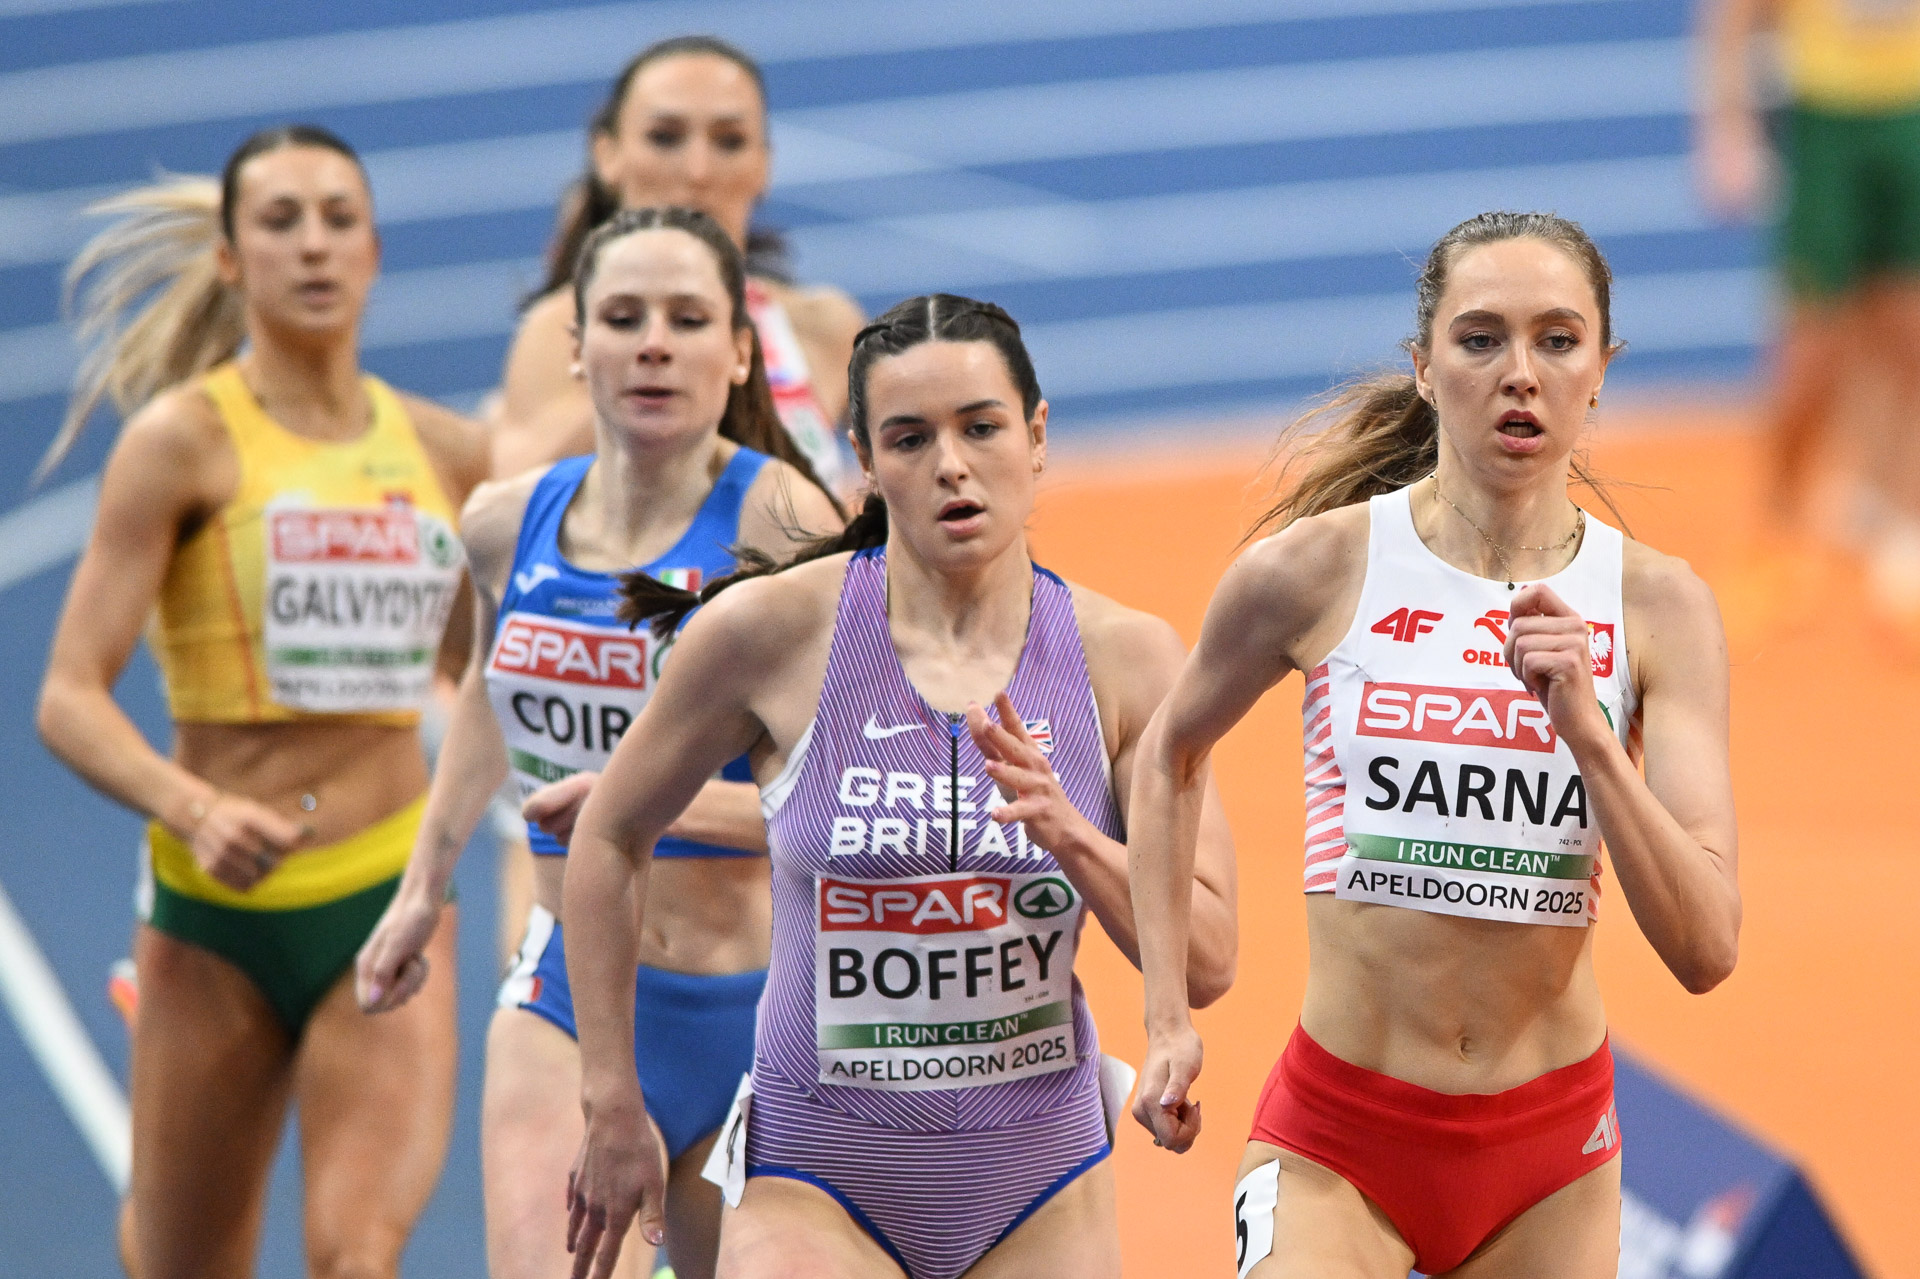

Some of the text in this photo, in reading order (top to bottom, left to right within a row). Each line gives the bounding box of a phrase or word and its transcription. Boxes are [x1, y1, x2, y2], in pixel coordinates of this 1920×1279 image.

[1370, 607, 1444, 643] 4F
[498, 627, 642, 684] SPAR
[1462, 649, 1510, 667] ORL
[512, 691, 633, 751] COIR
[1364, 689, 1551, 743] SPAR
[839, 767, 1060, 813] GRE
[1365, 756, 1588, 829] SARNA
[1398, 841, 1404, 860] I
[1410, 842, 1464, 866] RUN
[826, 883, 1003, 927] SPAR
[1347, 870, 1584, 914] APELDOORN 2025
[829, 930, 1063, 1000] BOFFEY
[875, 1026, 881, 1045] I
[887, 1025, 938, 1045] RUN
[831, 1036, 1067, 1081] APELDOORN 2025
